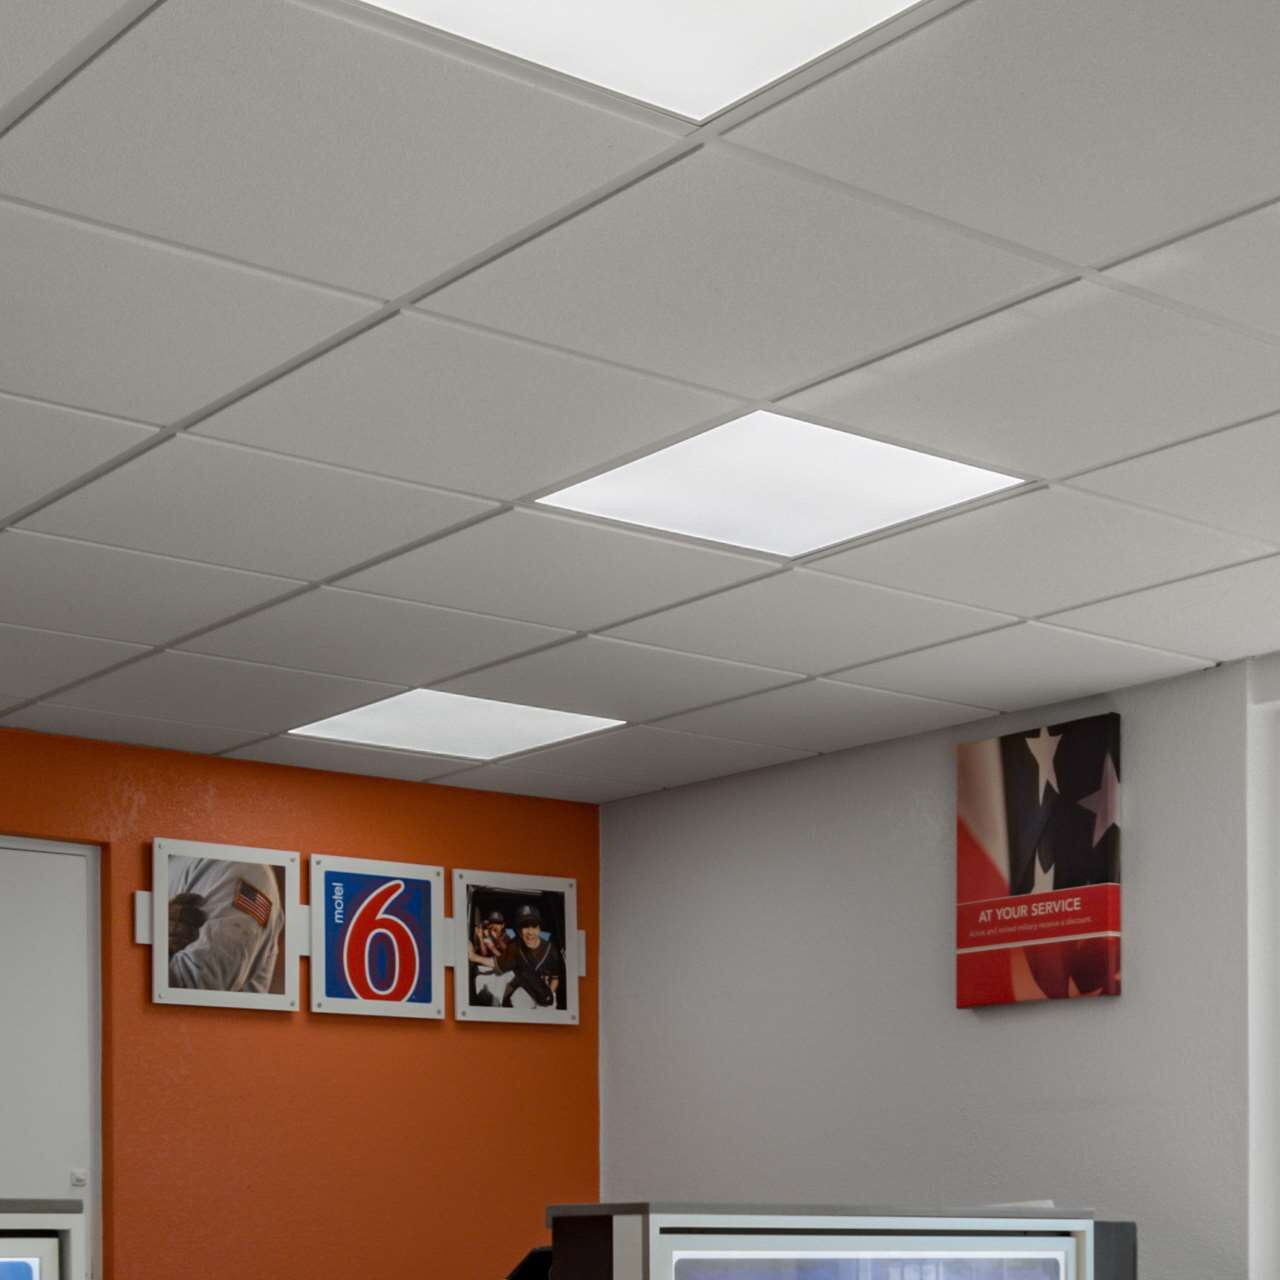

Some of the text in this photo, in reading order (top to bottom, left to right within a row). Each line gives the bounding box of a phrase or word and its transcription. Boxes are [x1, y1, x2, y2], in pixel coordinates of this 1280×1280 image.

[331, 880, 419, 1003] motel 6
[978, 897, 1081, 923] AT YOUR SERVICE
